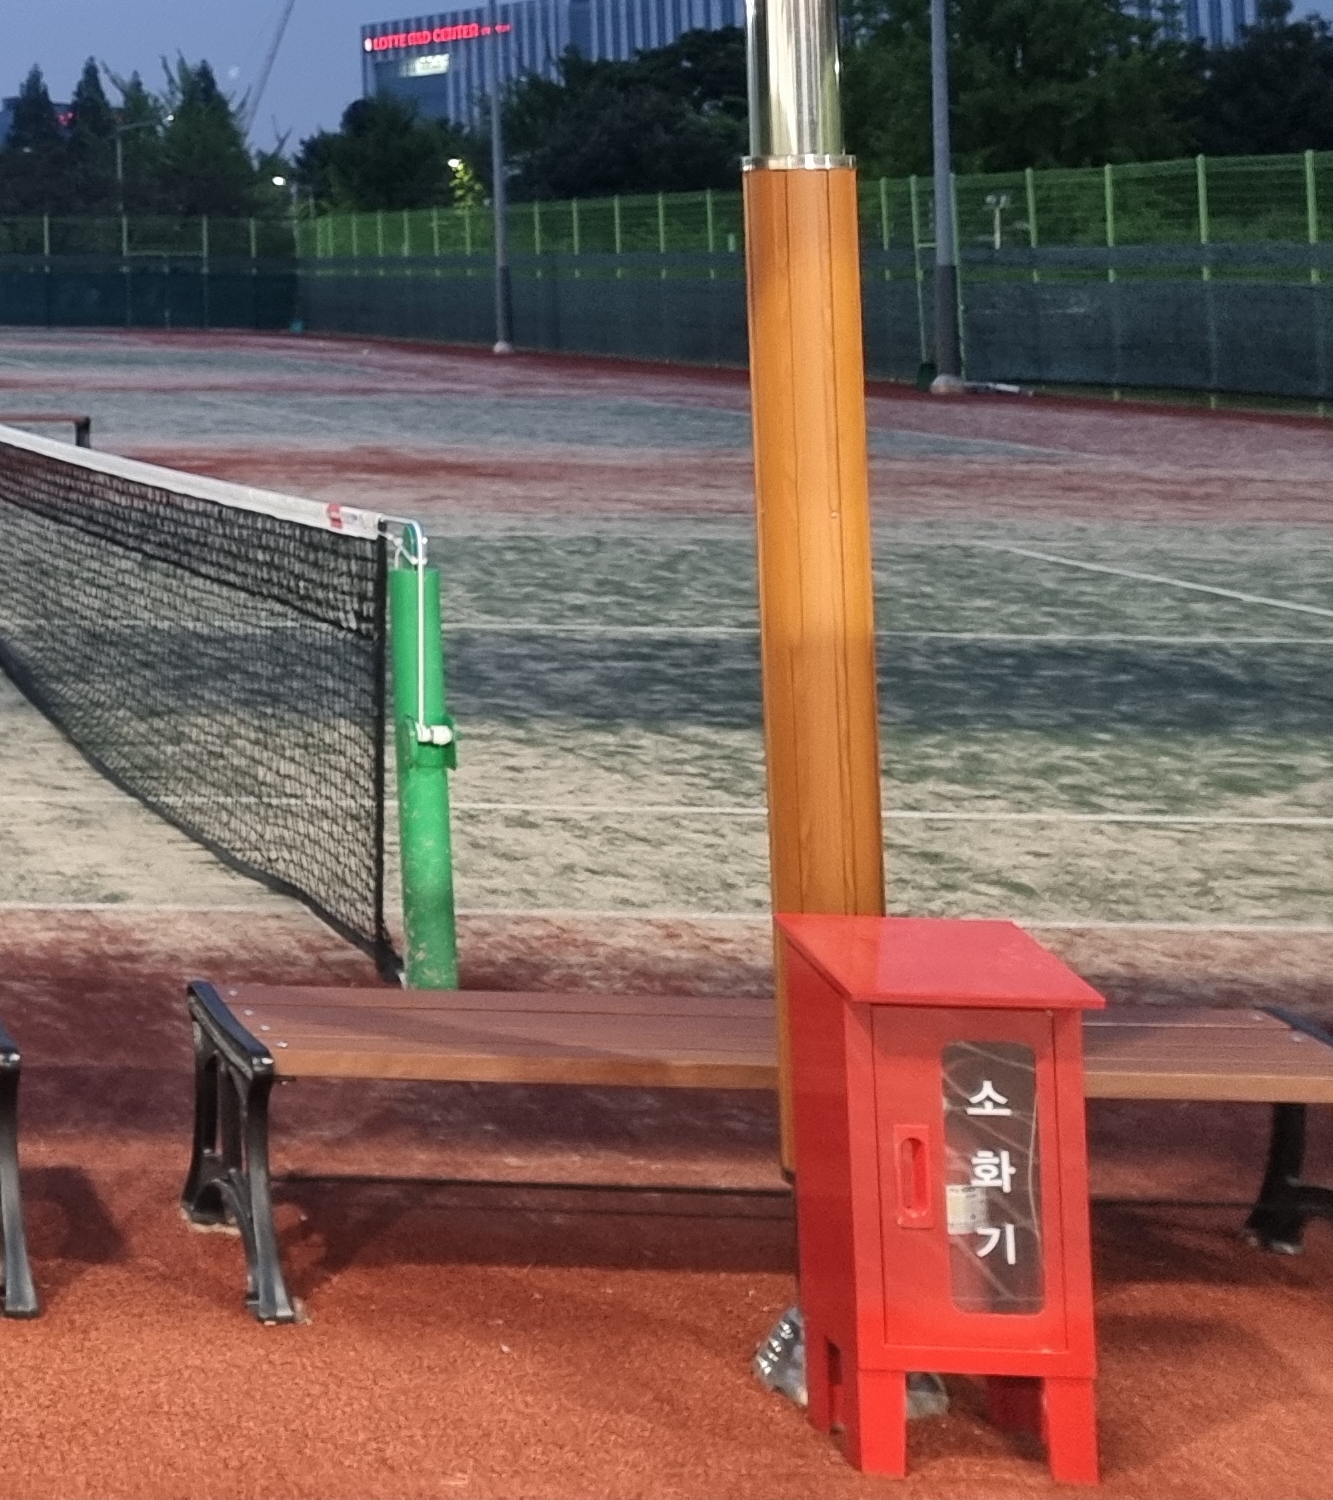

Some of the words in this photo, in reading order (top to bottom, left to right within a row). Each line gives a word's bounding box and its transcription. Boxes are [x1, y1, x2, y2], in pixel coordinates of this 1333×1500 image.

[373, 33, 407, 51] LOTTE
[433, 23, 479, 42] CENTER
[965, 1080, 1017, 1265] 소화기
